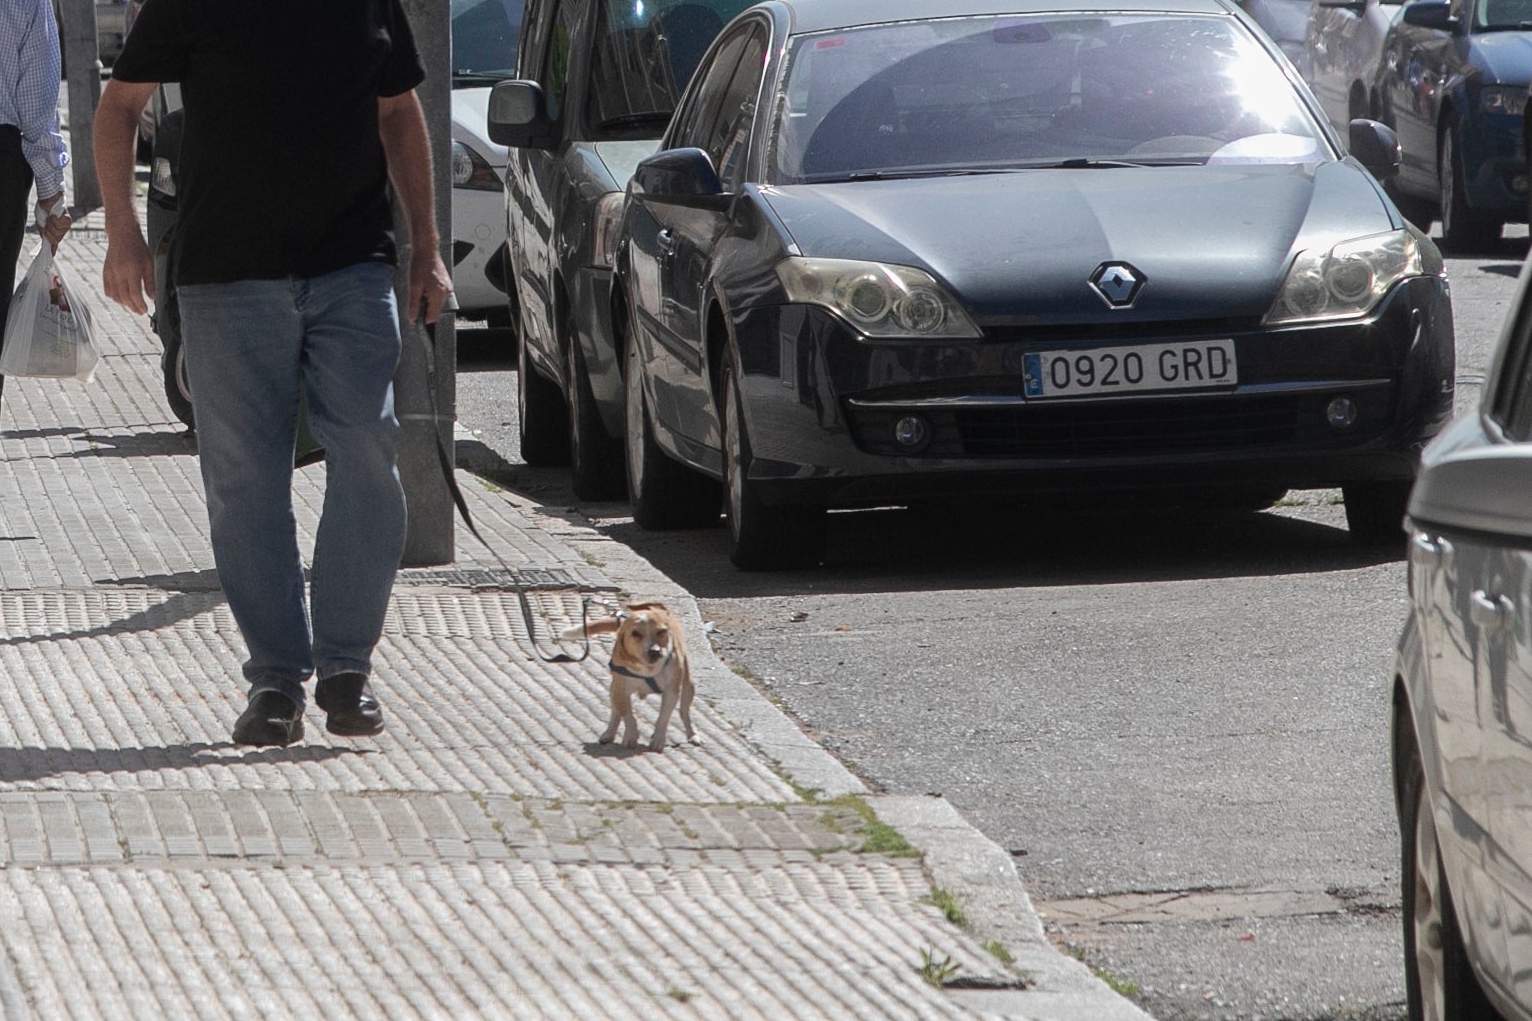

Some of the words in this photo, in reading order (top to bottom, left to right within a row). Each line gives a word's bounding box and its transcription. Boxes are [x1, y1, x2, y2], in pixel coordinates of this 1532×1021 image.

[1050, 352, 1144, 389] 0920
[1158, 346, 1229, 382] GRD
[1030, 379, 1039, 389] E
